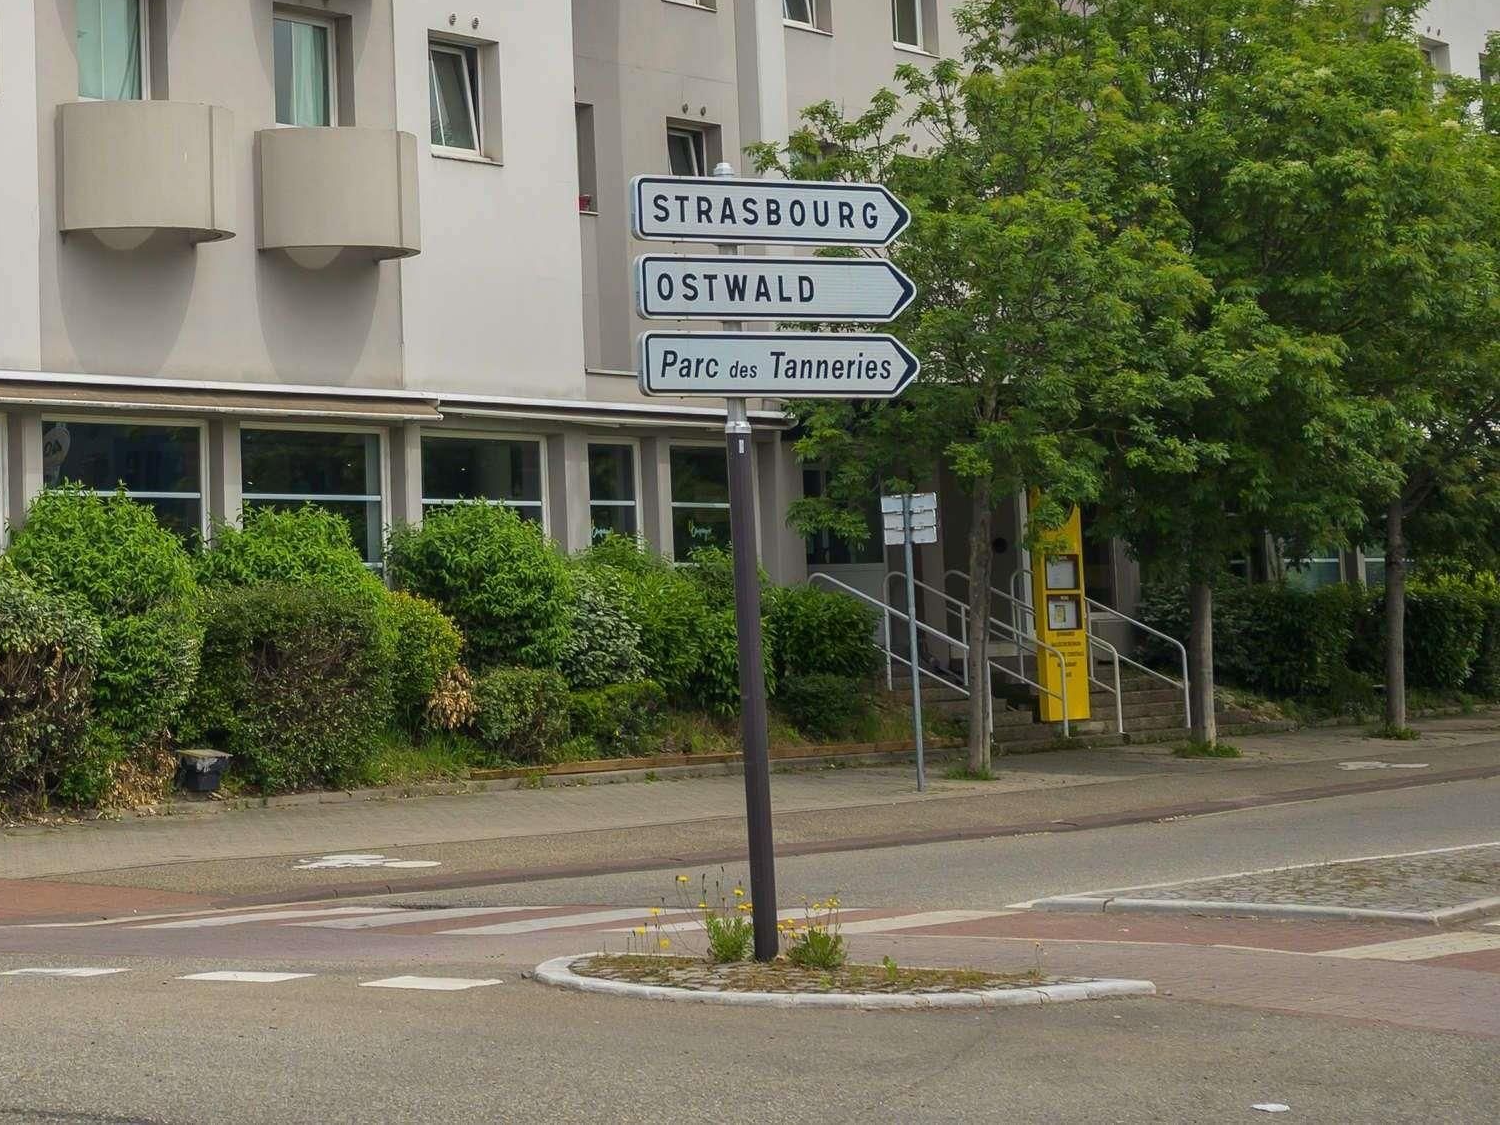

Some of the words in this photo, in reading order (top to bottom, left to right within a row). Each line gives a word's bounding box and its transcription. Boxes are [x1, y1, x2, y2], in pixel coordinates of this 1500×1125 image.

[653, 194, 879, 229] STRASBOURG
[657, 273, 815, 303] OSTWALD
[660, 350, 720, 379] Parc
[729, 360, 758, 379] des
[770, 351, 892, 380] Tanneries
